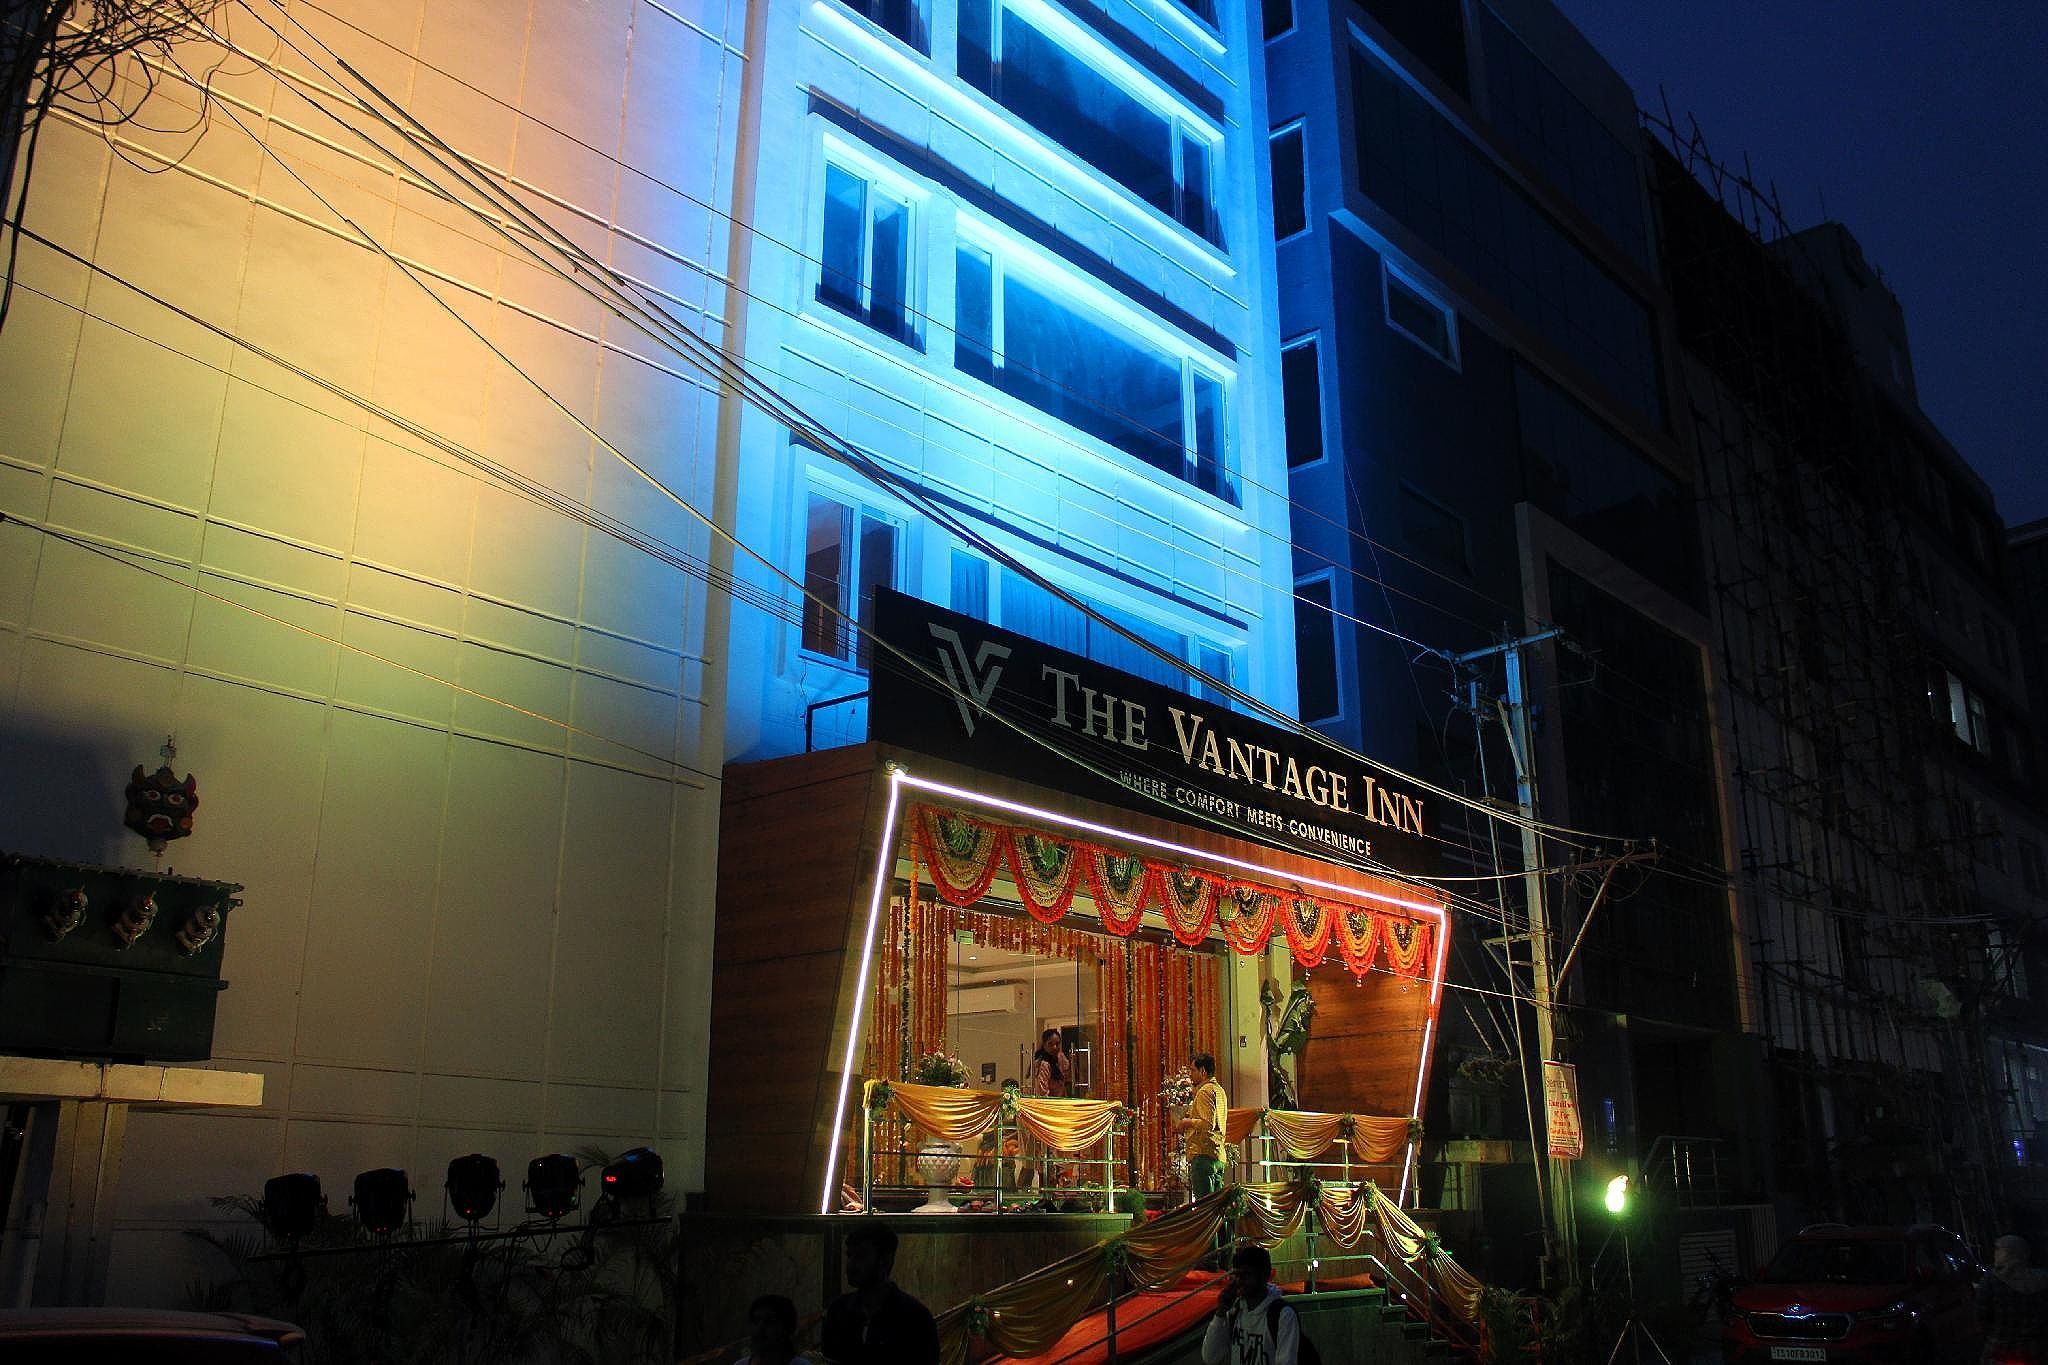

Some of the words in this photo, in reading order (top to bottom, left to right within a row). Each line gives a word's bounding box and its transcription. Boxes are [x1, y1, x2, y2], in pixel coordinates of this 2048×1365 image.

[1120, 769, 1167, 800] WHERE
[1176, 787, 1240, 818] COMFORT
[1247, 807, 1283, 831] MEETS
[1290, 820, 1371, 855] CONVENIENCE
